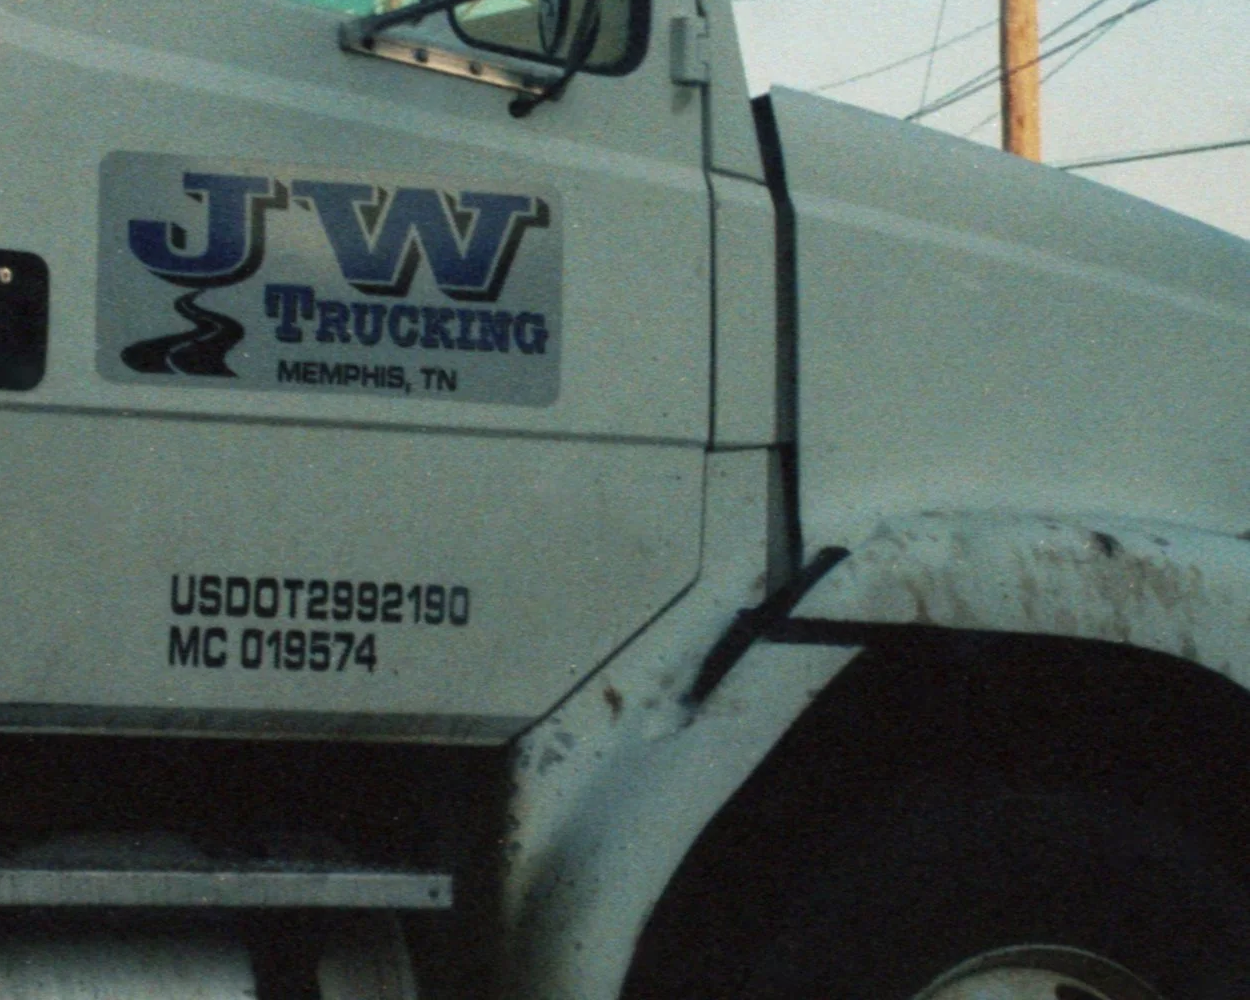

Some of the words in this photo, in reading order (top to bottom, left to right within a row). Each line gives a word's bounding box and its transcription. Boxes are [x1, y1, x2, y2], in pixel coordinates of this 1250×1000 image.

[264, 283, 548, 354] TRUCKING
[277, 359, 411, 393] MEMPHIS,
[421, 369, 457, 391] TN
[170, 574, 471, 626] USDOT2992190
[168, 625, 227, 668] MC
[240, 628, 377, 673] 019574
